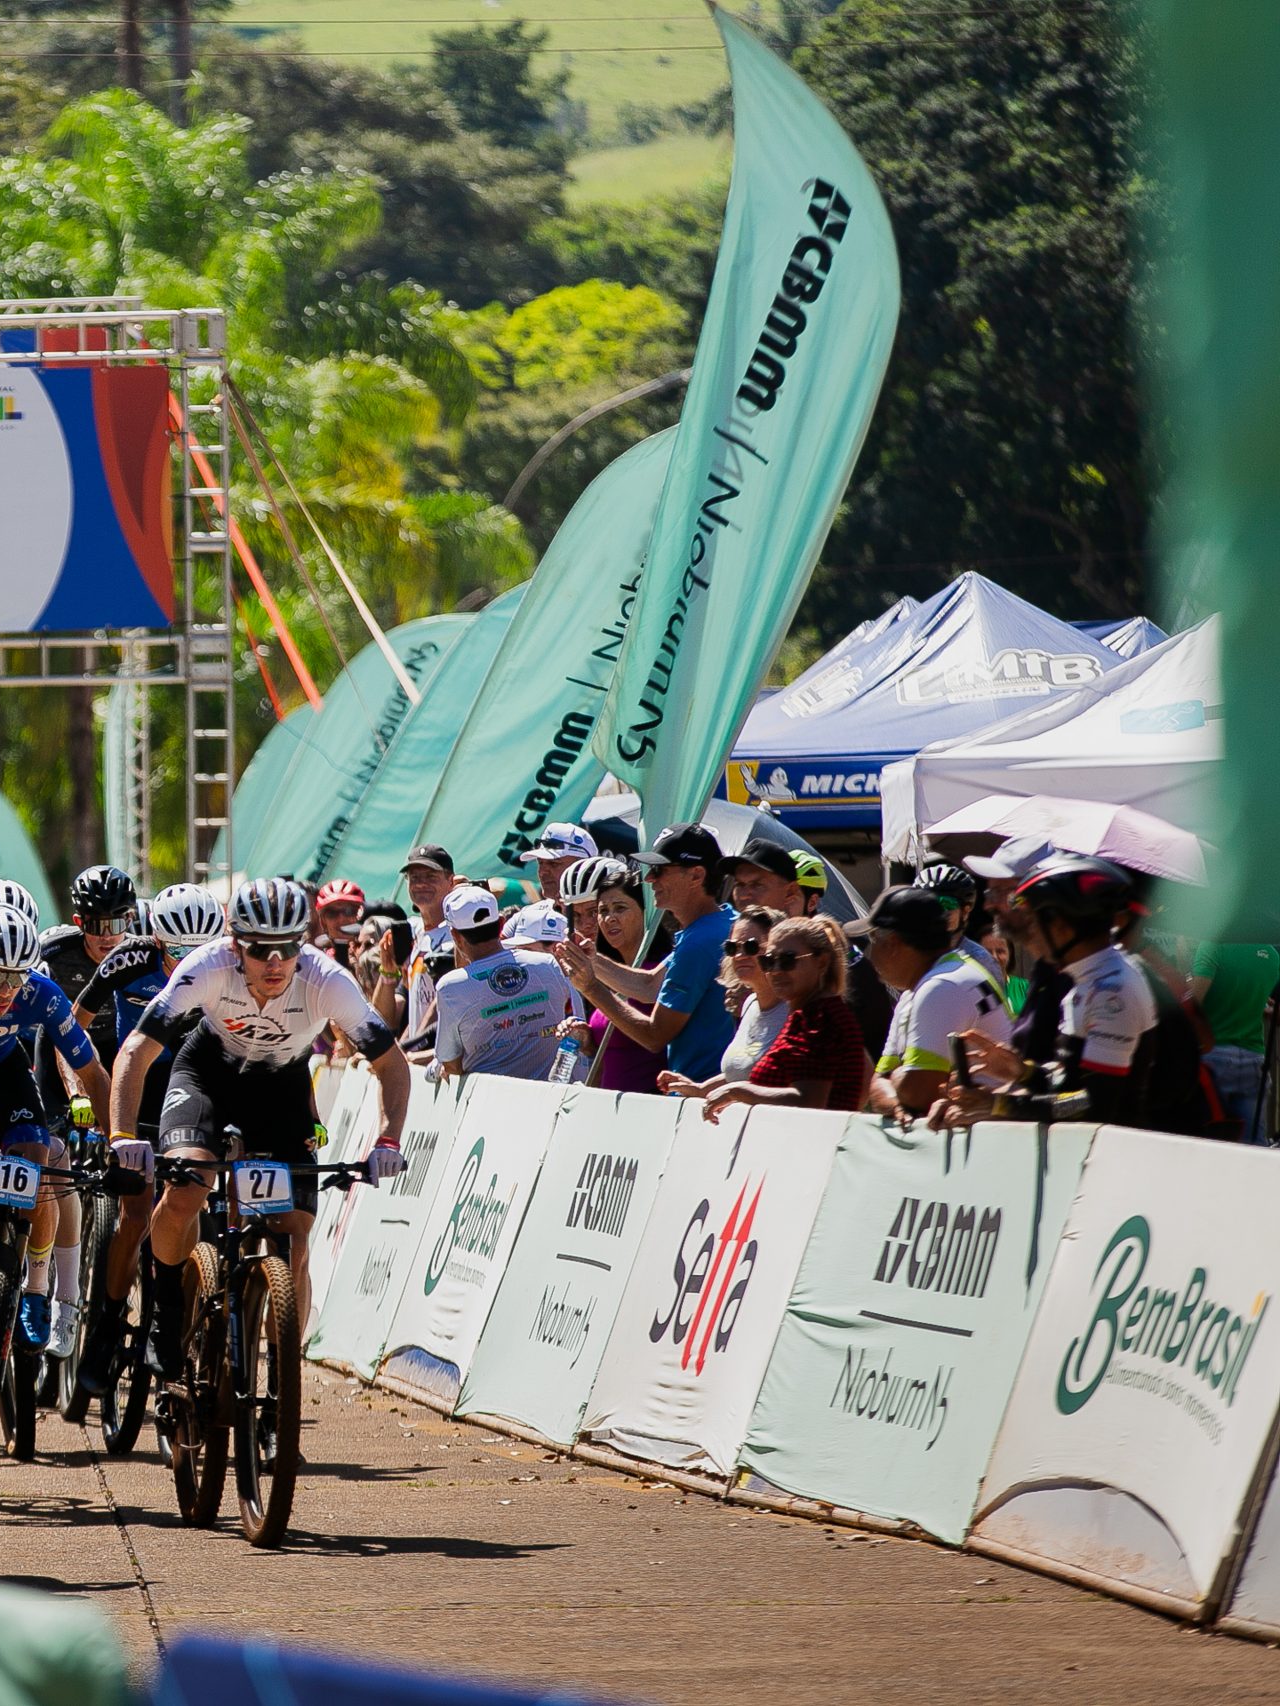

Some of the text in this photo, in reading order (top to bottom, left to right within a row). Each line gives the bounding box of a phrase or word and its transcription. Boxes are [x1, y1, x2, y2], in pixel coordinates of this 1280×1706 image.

[1, 1164, 29, 1193] 16
[249, 1169, 276, 1199] 27
[648, 1169, 767, 1378] Setta
[1054, 1214, 1273, 1416] BemBrasil
